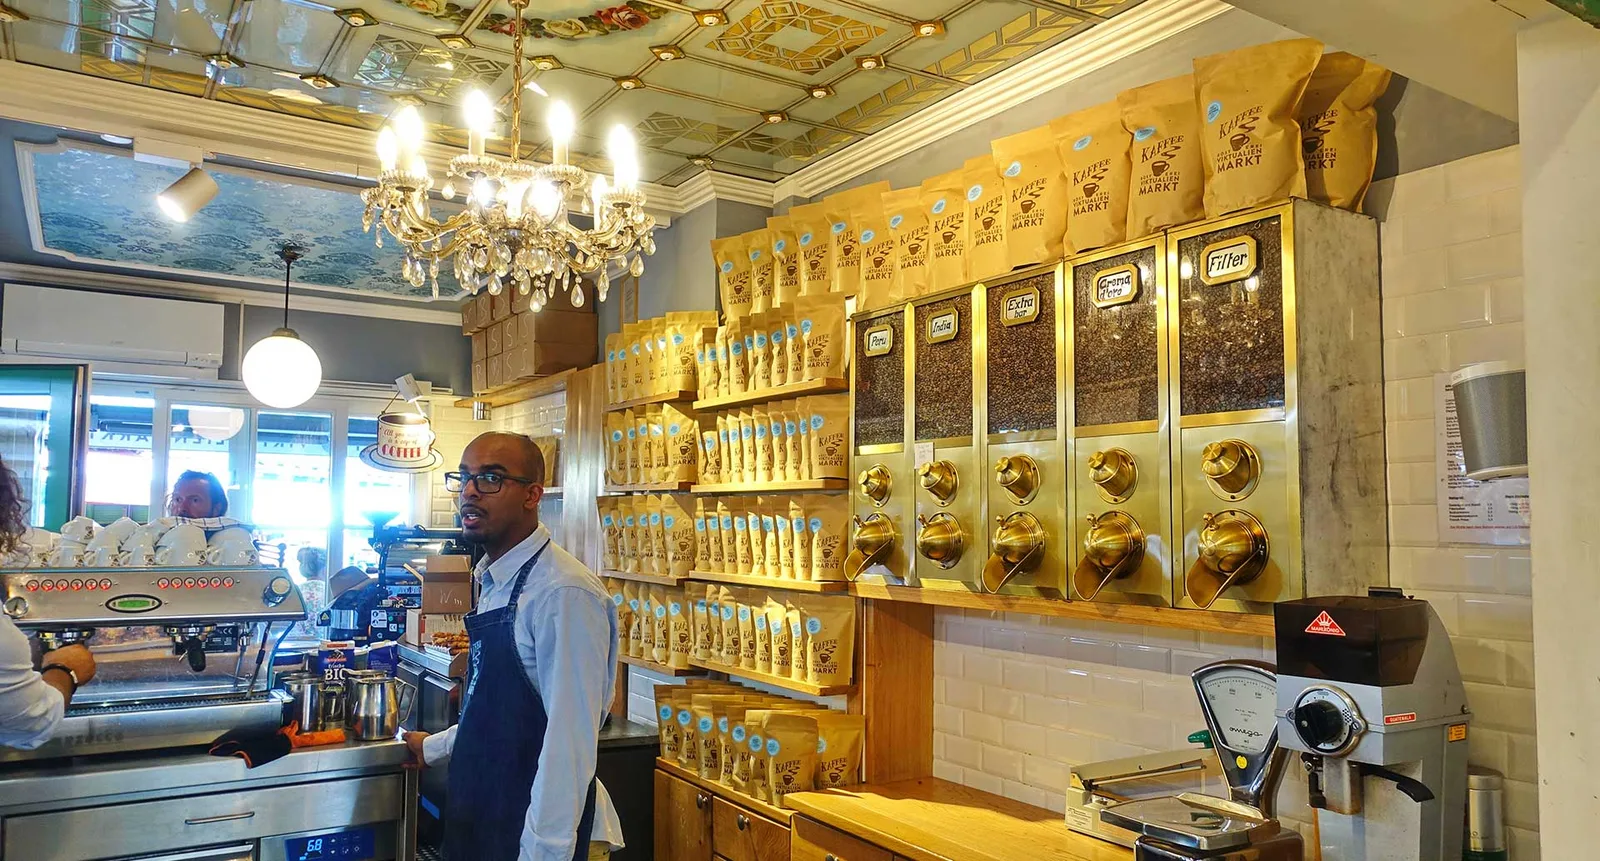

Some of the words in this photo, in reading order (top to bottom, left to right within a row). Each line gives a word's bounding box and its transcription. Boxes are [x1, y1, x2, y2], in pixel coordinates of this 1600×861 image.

[1219, 105, 1263, 140] KAFFEE
[1141, 135, 1184, 163] KAFFEE
[1217, 148, 1262, 163] VIKTUALIEN
[1217, 155, 1262, 174] MARKT
[1308, 158, 1336, 170] RKT
[1073, 158, 1111, 187] KAFFEE
[1140, 175, 1180, 186] VIKTUALIEN
[1012, 178, 1047, 203] KAFFEE
[1138, 182, 1179, 196] MARKT
[1073, 201, 1109, 217] MARKT
[1011, 217, 1044, 231] MARKT
[935, 248, 964, 259] MARKT
[900, 259, 925, 270] MARK
[1208, 251, 1248, 273] Filter
[865, 272, 893, 281] MARKT
[1008, 296, 1033, 312] Extra
[1014, 309, 1027, 319] bar
[932, 321, 951, 334] India
[871, 335, 887, 347] Peru
[813, 667, 838, 675] MARKT
